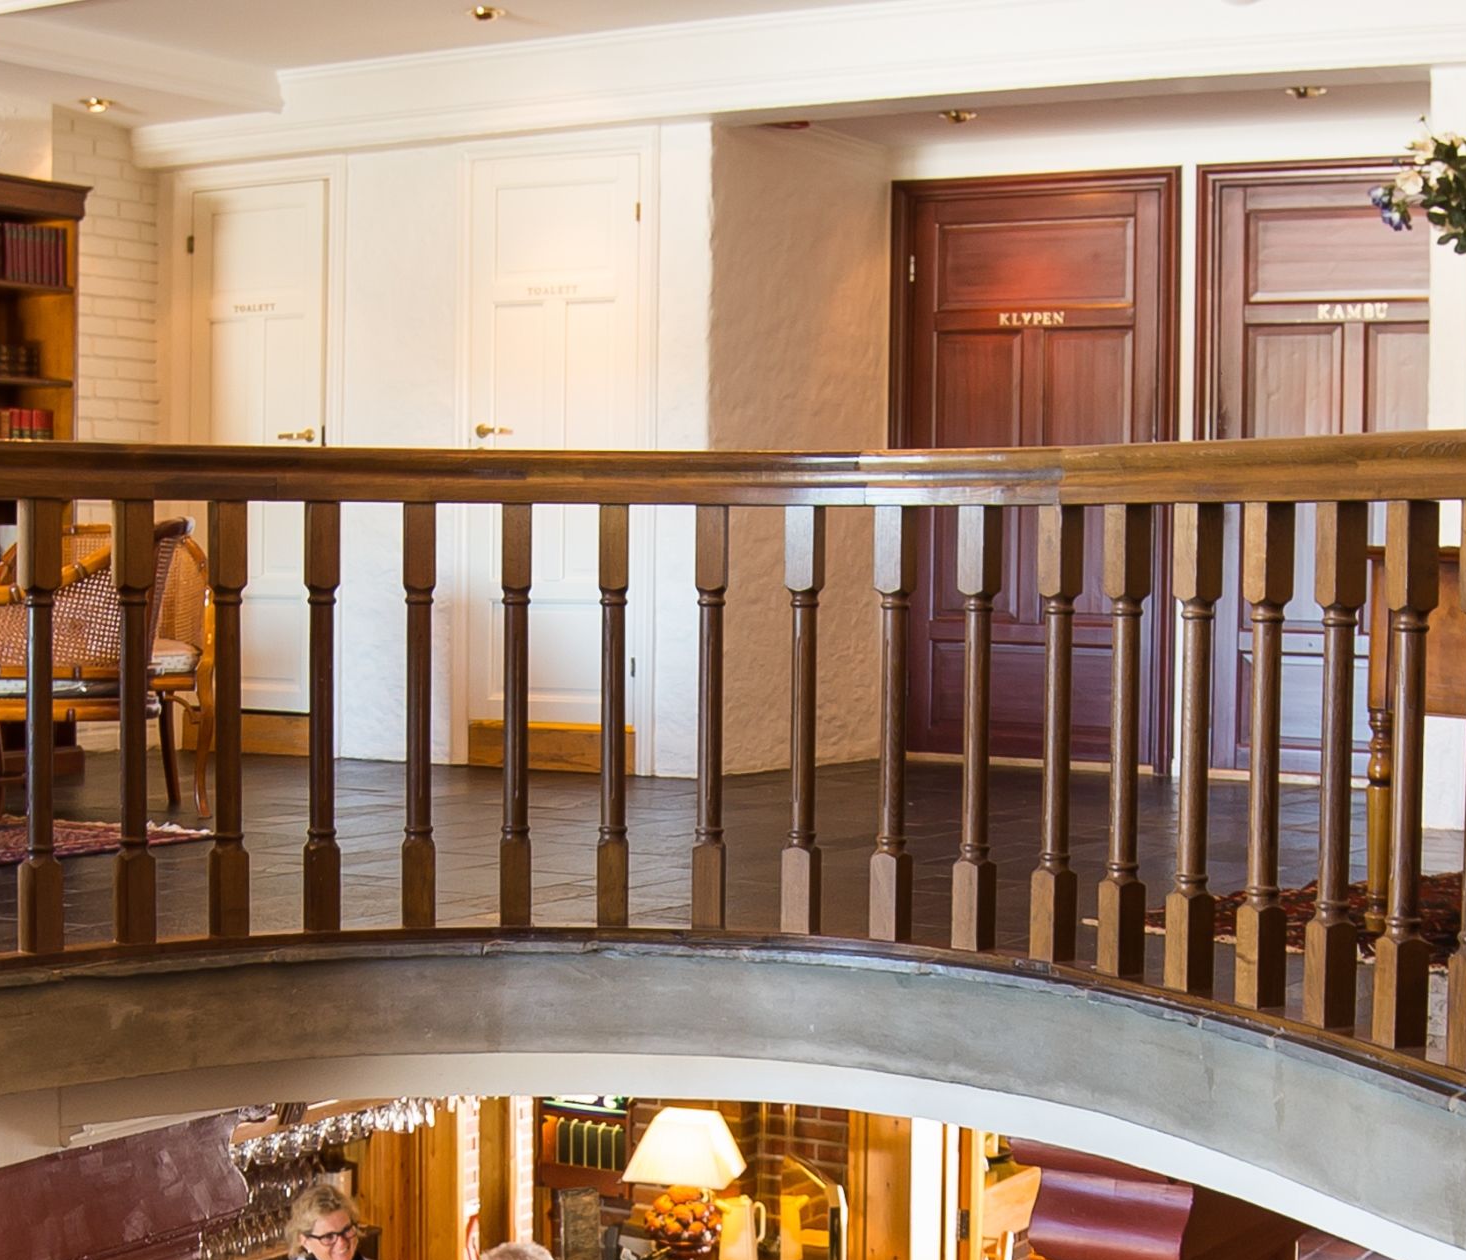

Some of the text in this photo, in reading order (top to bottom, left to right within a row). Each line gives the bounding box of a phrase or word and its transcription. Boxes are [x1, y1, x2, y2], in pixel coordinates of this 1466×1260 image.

[527, 284, 578, 296] TOALETT
[233, 303, 276, 313] TOALETT
[998, 311, 1065, 326] KLYPEN
